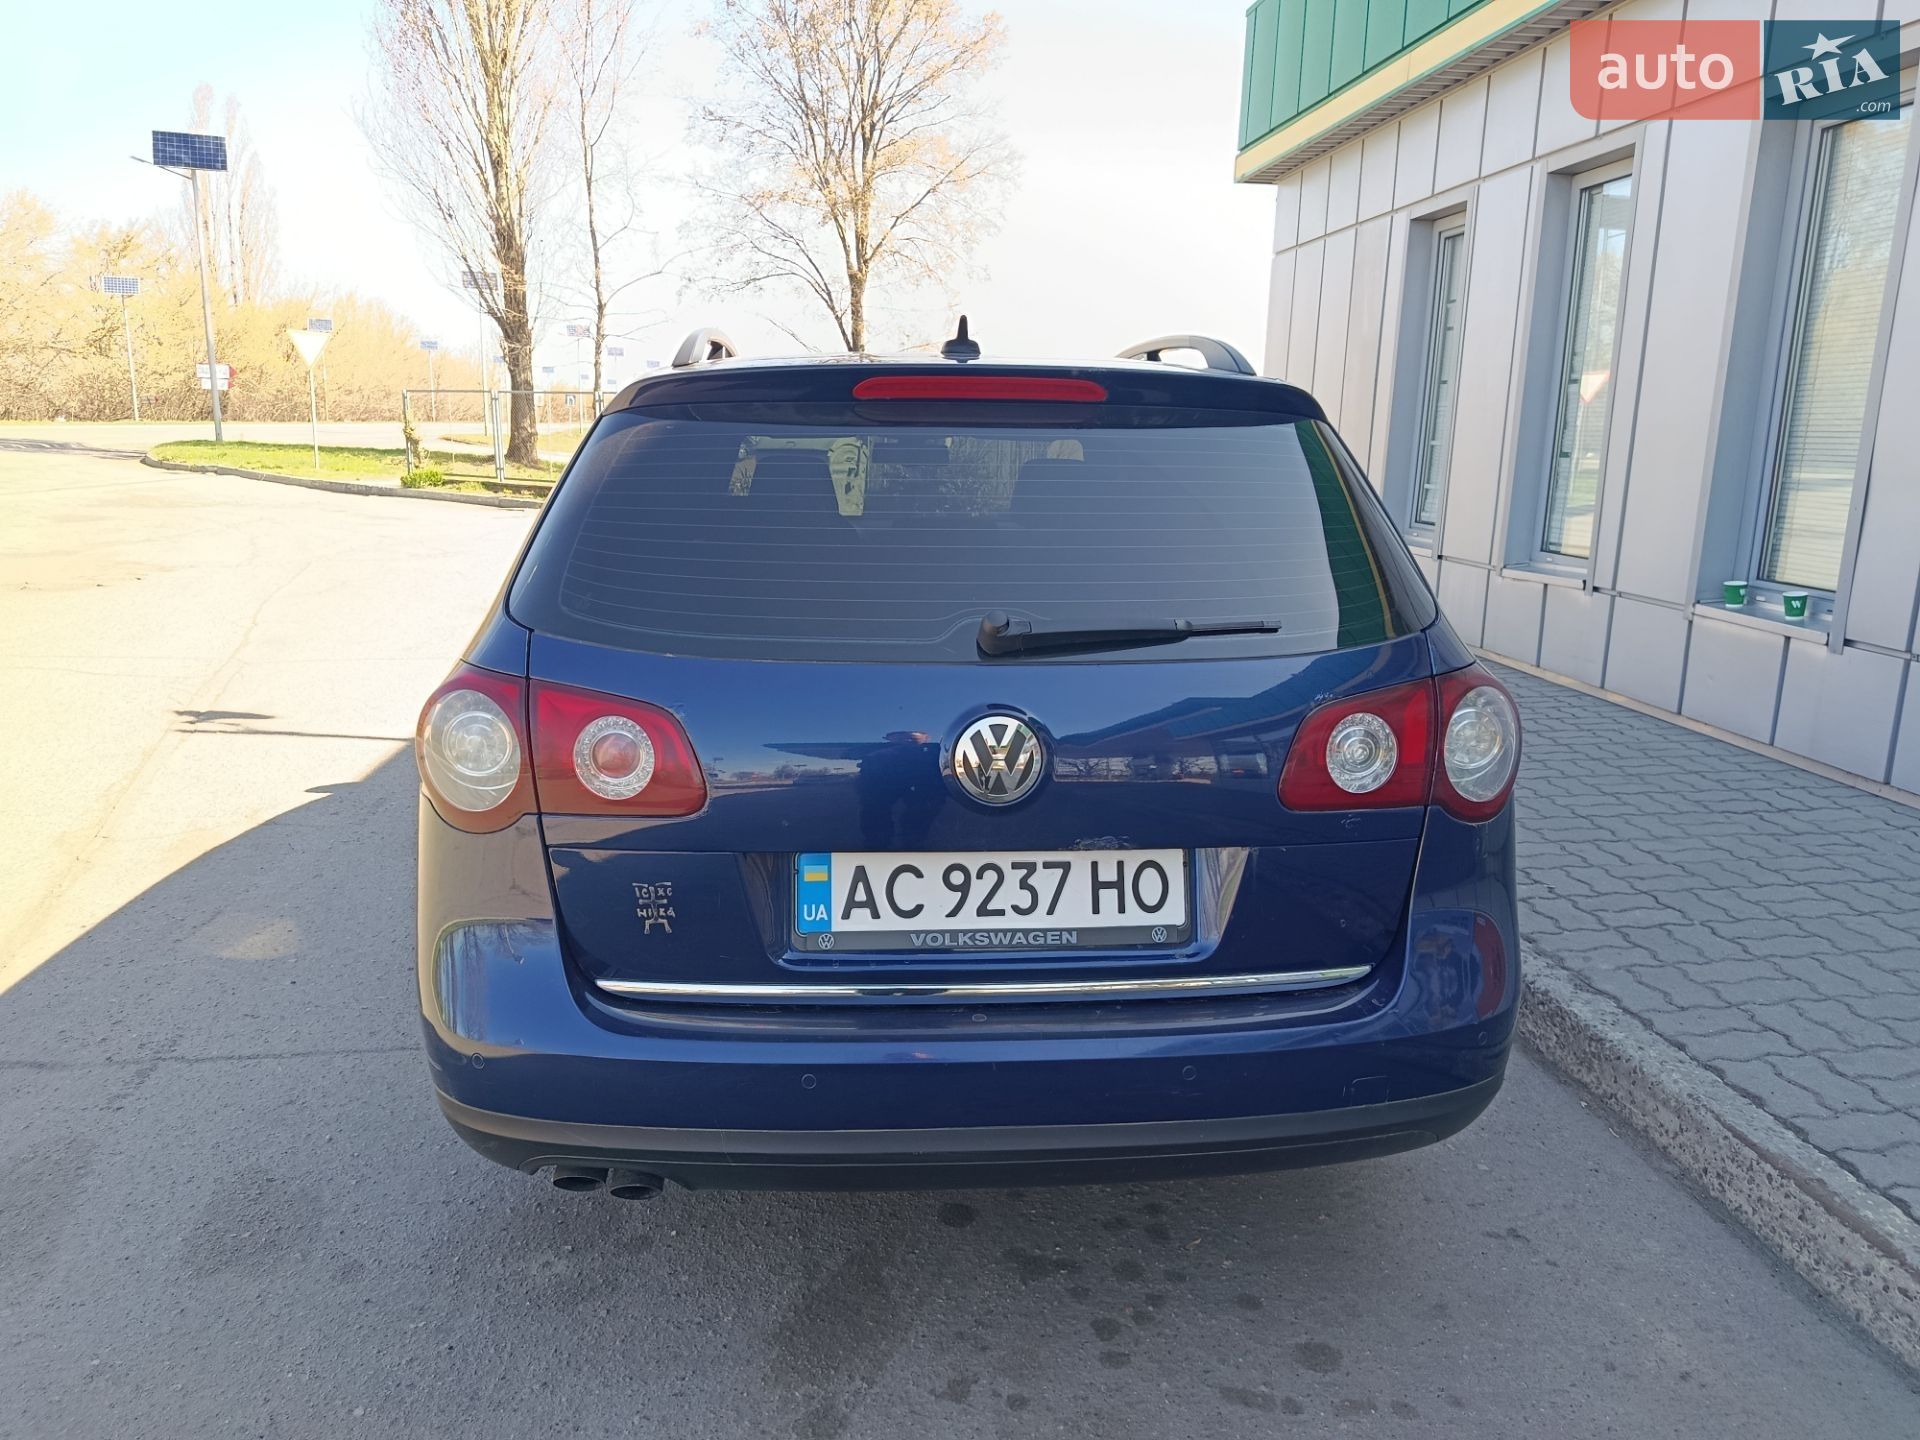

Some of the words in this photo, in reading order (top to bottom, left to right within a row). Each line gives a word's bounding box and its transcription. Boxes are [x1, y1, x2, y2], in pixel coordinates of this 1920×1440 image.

[841, 863, 925, 921] AC
[942, 861, 1072, 918] 9237
[1091, 859, 1169, 915] HO
[804, 904, 828, 921] UA
[910, 931, 1078, 947] VOLKSWAGEN
